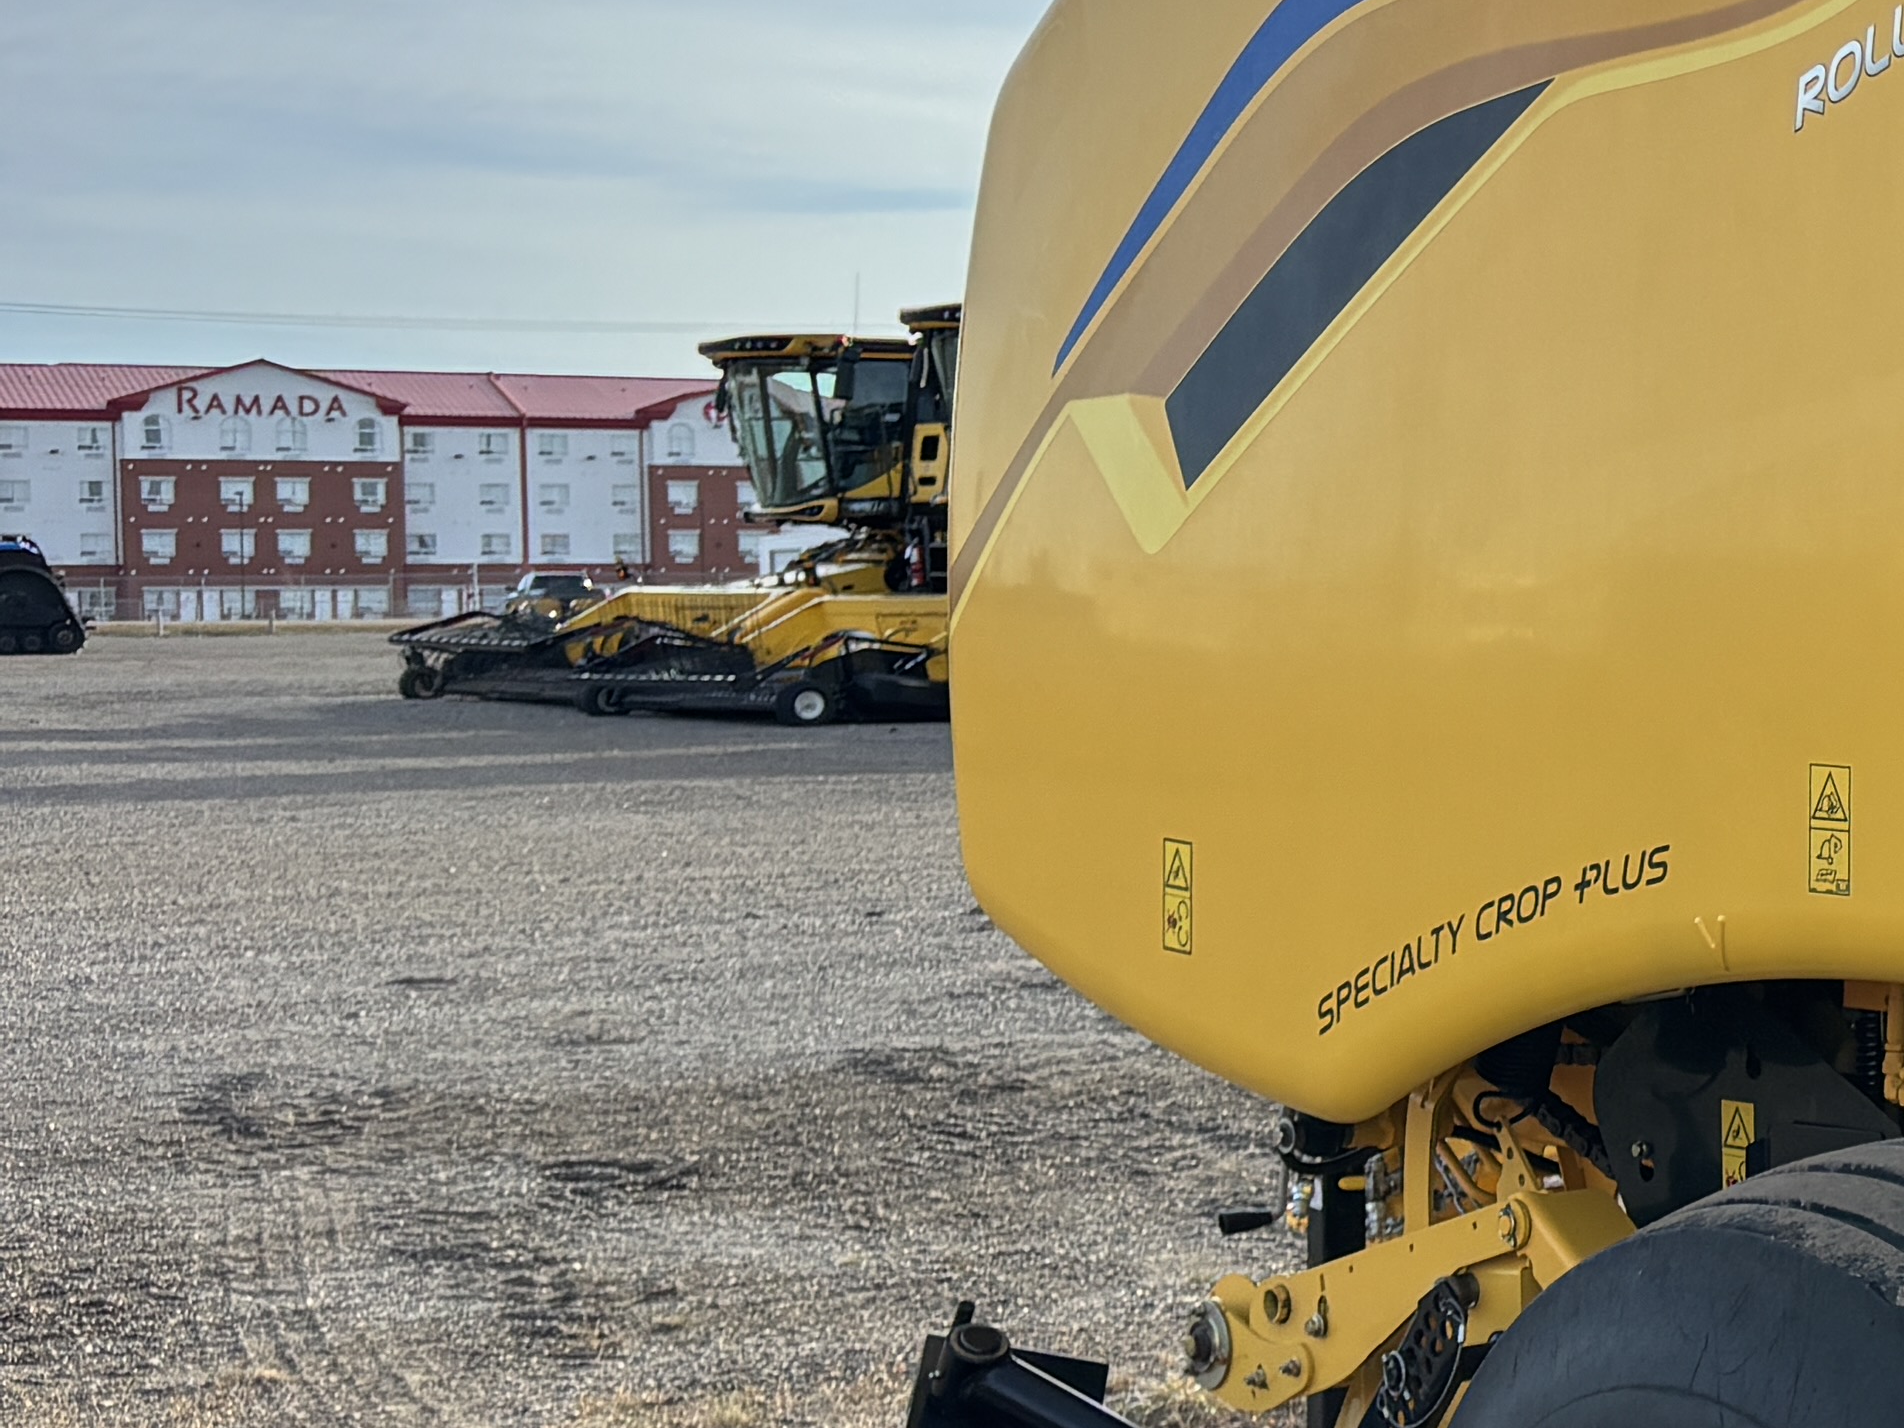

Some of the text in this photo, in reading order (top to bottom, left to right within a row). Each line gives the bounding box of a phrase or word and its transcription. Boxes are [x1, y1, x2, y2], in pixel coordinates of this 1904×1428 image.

[176, 385, 348, 418] RAMADA
[1317, 843, 1671, 1036] SPECIALTY CROP PLUS
